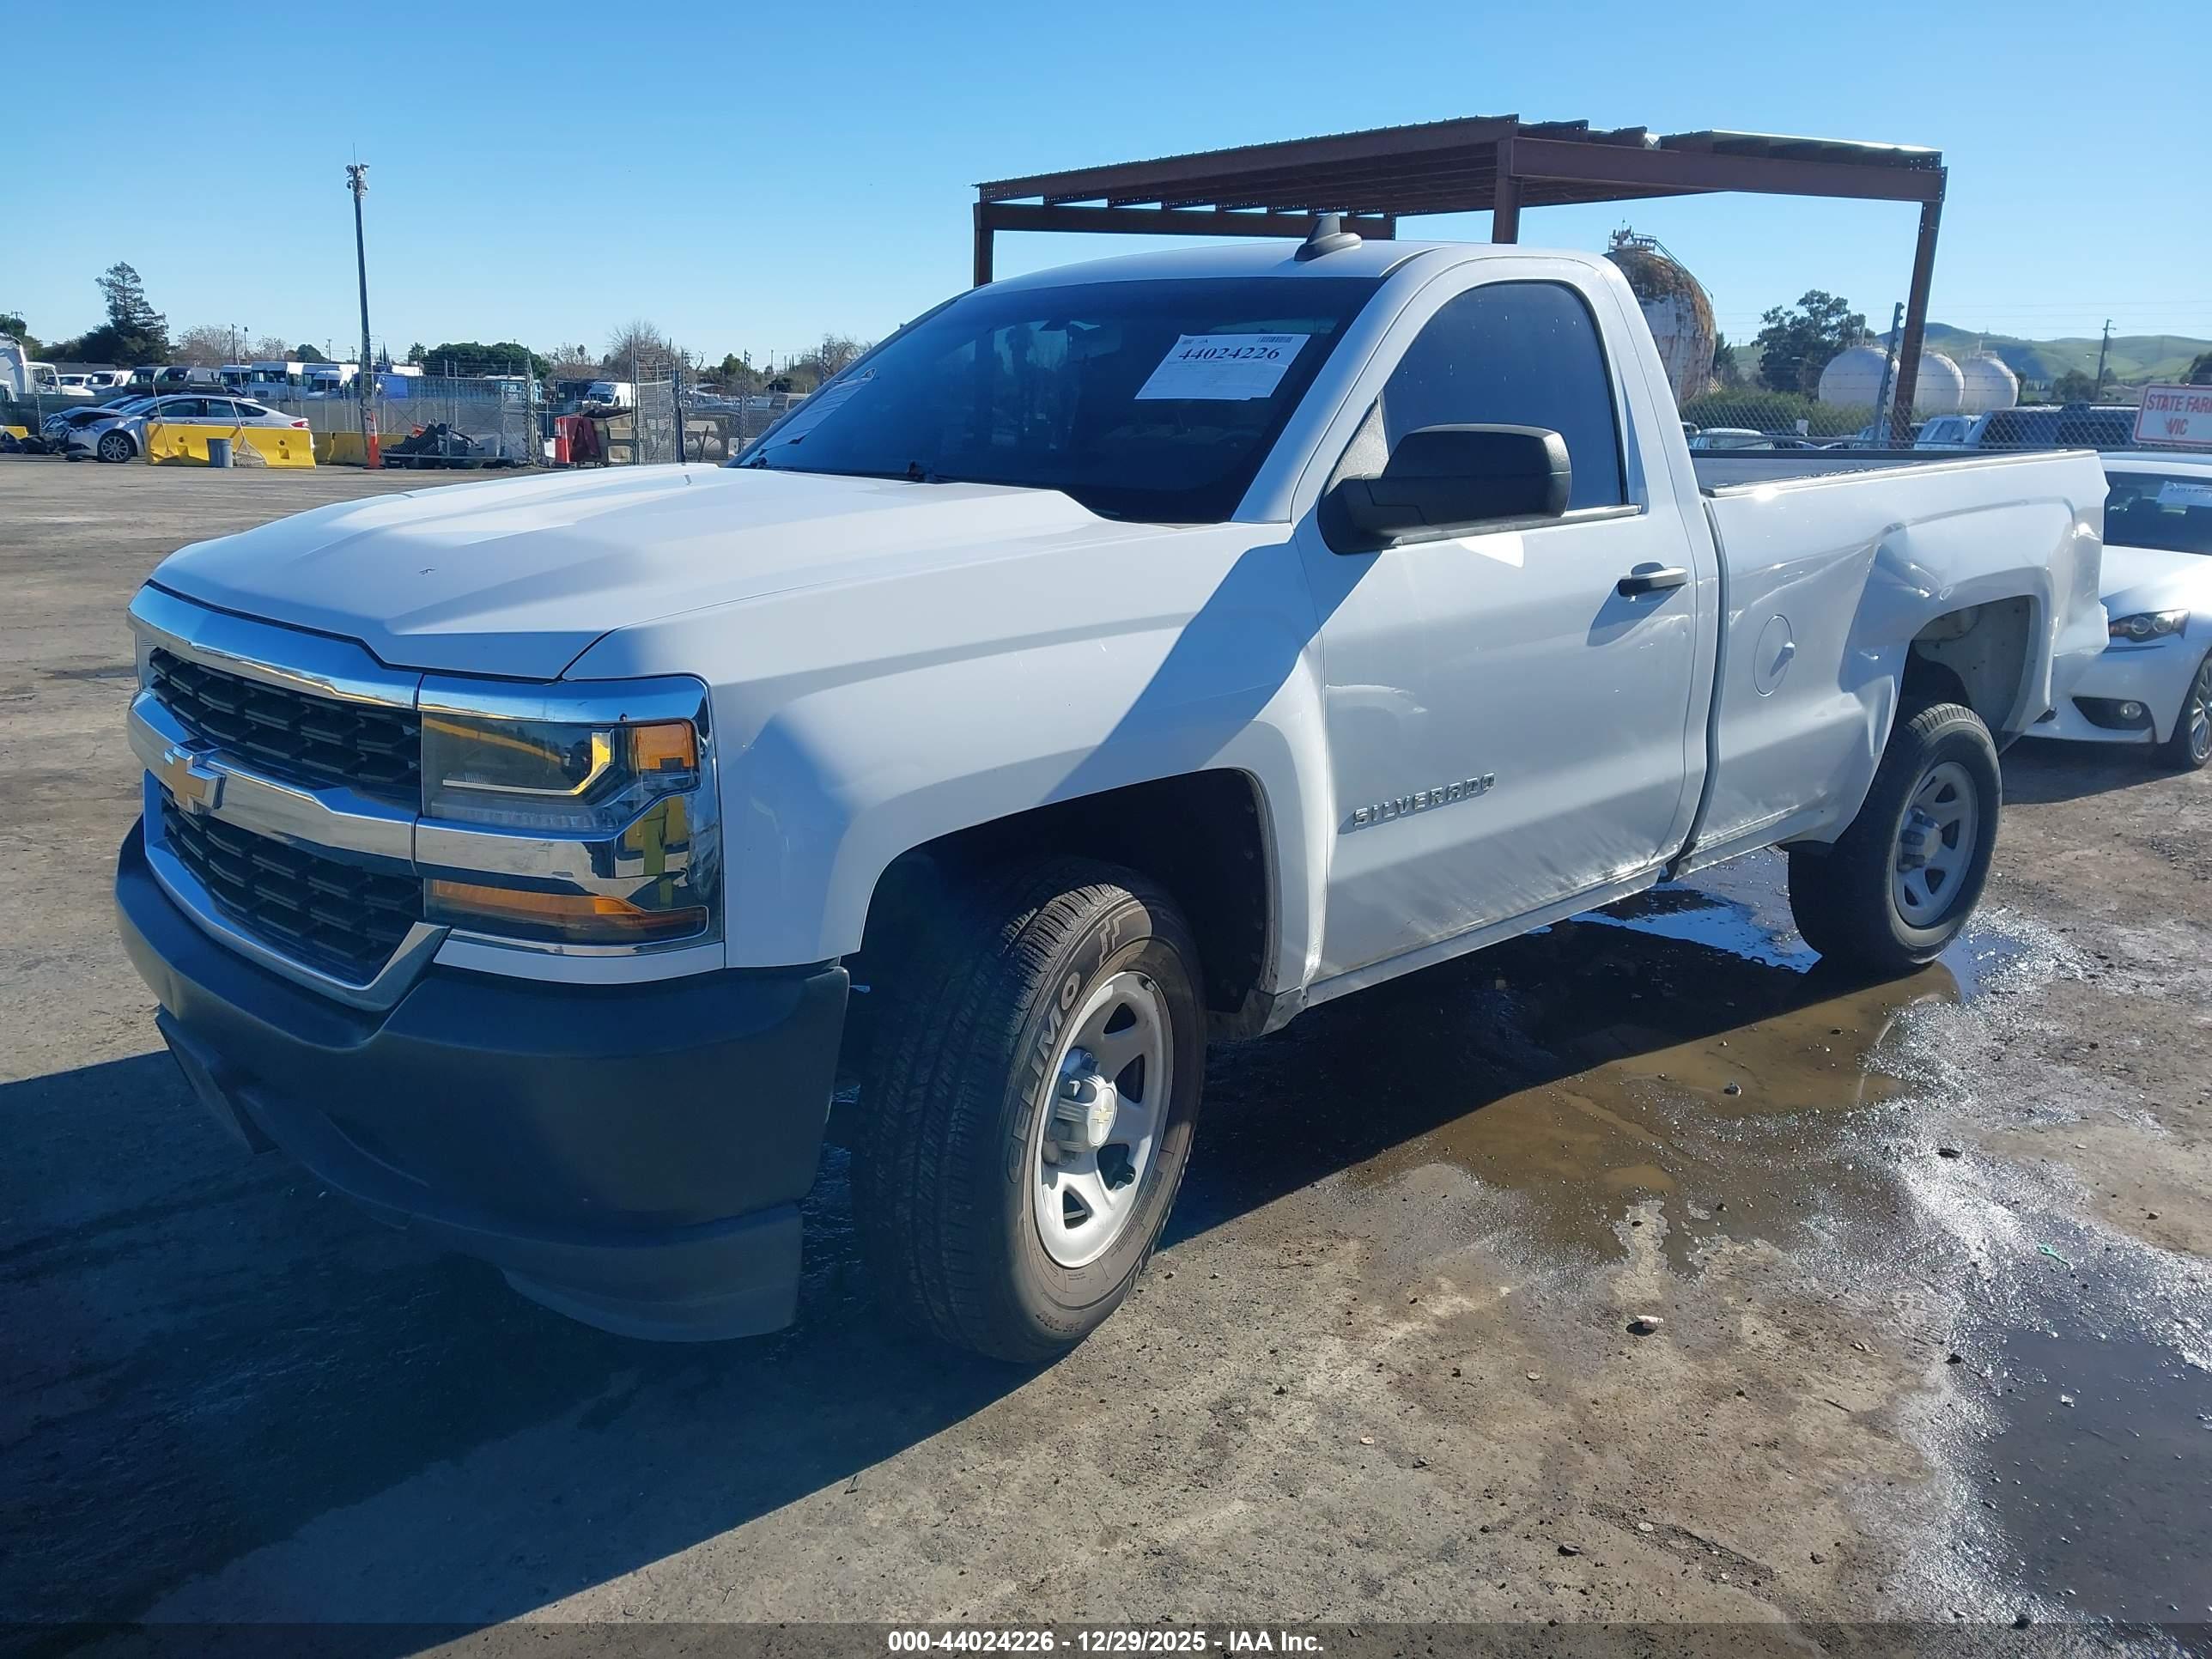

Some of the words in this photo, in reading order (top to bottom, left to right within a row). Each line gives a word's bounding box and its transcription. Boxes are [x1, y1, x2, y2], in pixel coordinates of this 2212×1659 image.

[1179, 346, 1283, 360] 44024226
[2147, 394, 2185, 411] STATE
[2166, 417, 2189, 435] VIC
[1352, 773, 1496, 827] SILVERADO
